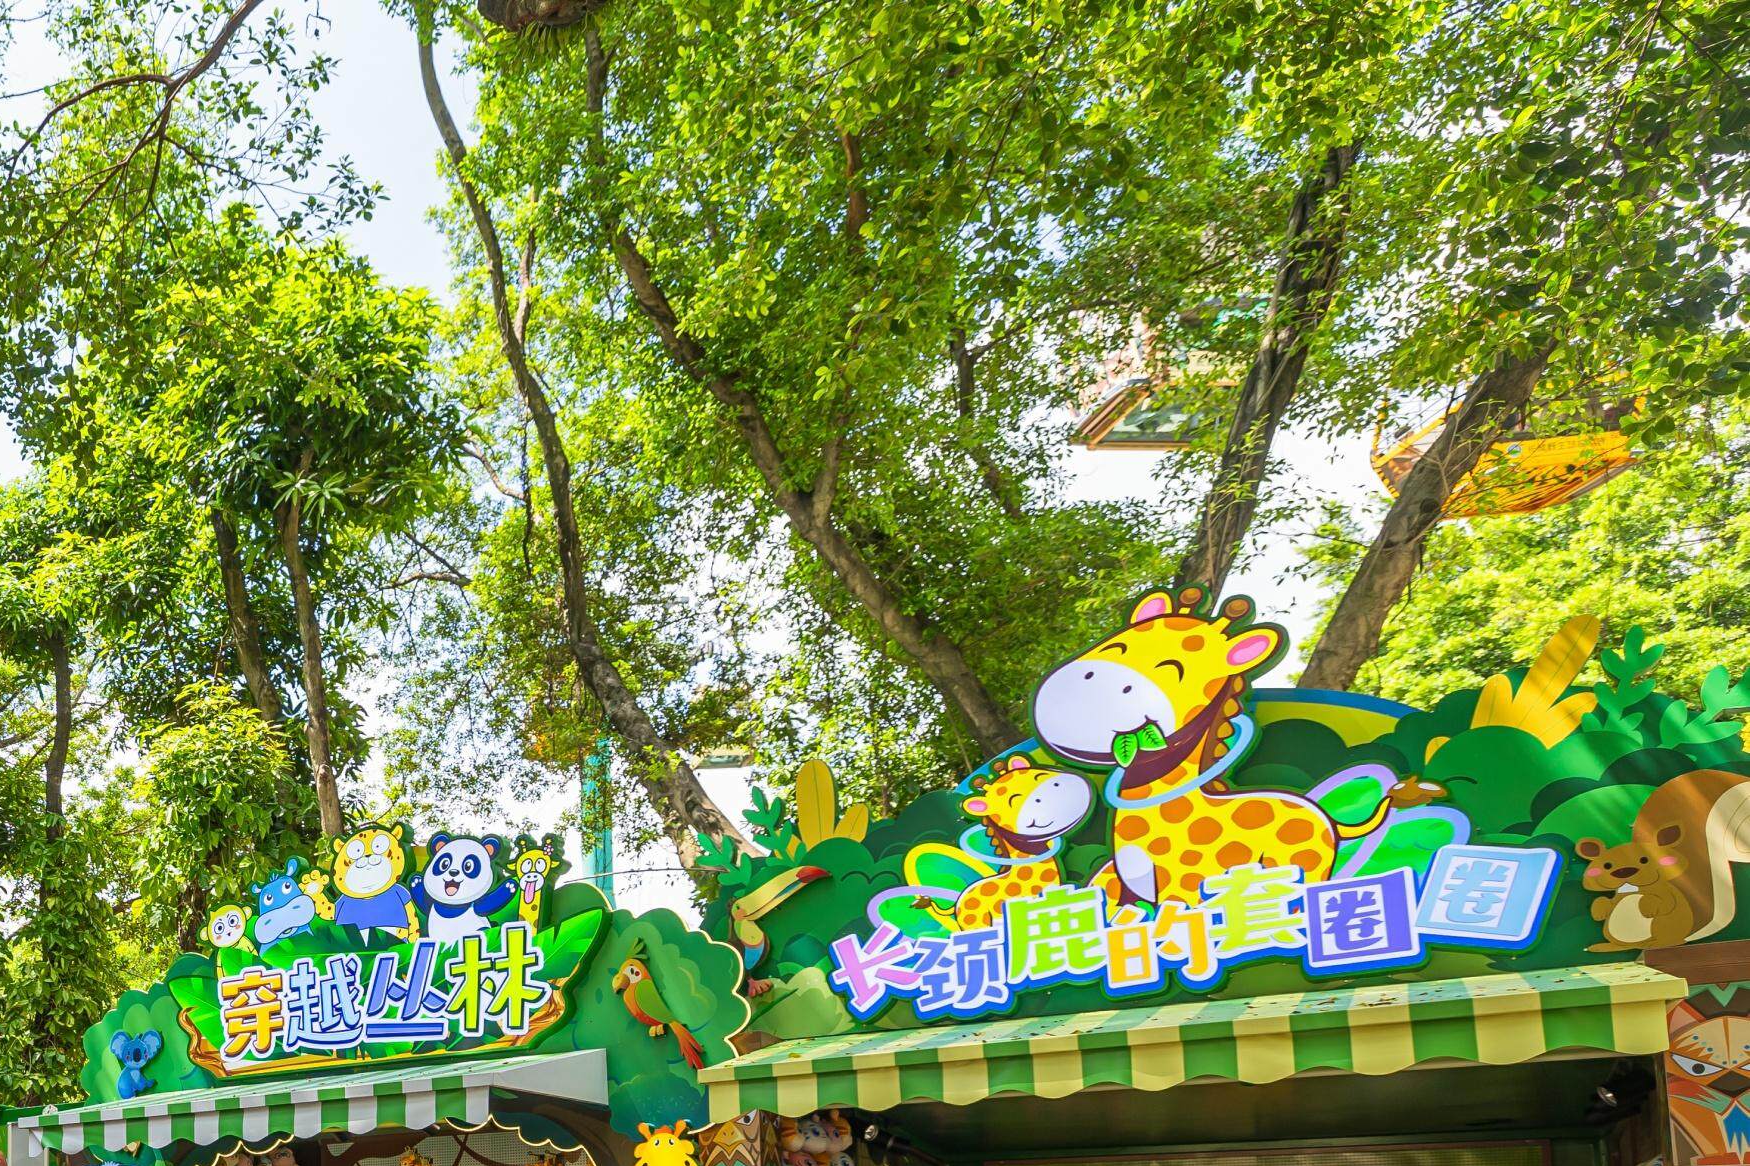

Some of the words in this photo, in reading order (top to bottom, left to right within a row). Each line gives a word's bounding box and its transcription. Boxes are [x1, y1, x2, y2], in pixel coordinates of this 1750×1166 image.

[219, 925, 548, 1057] 穿越丛林
[832, 846, 1556, 1010] 长颈鹿的套圈圈
